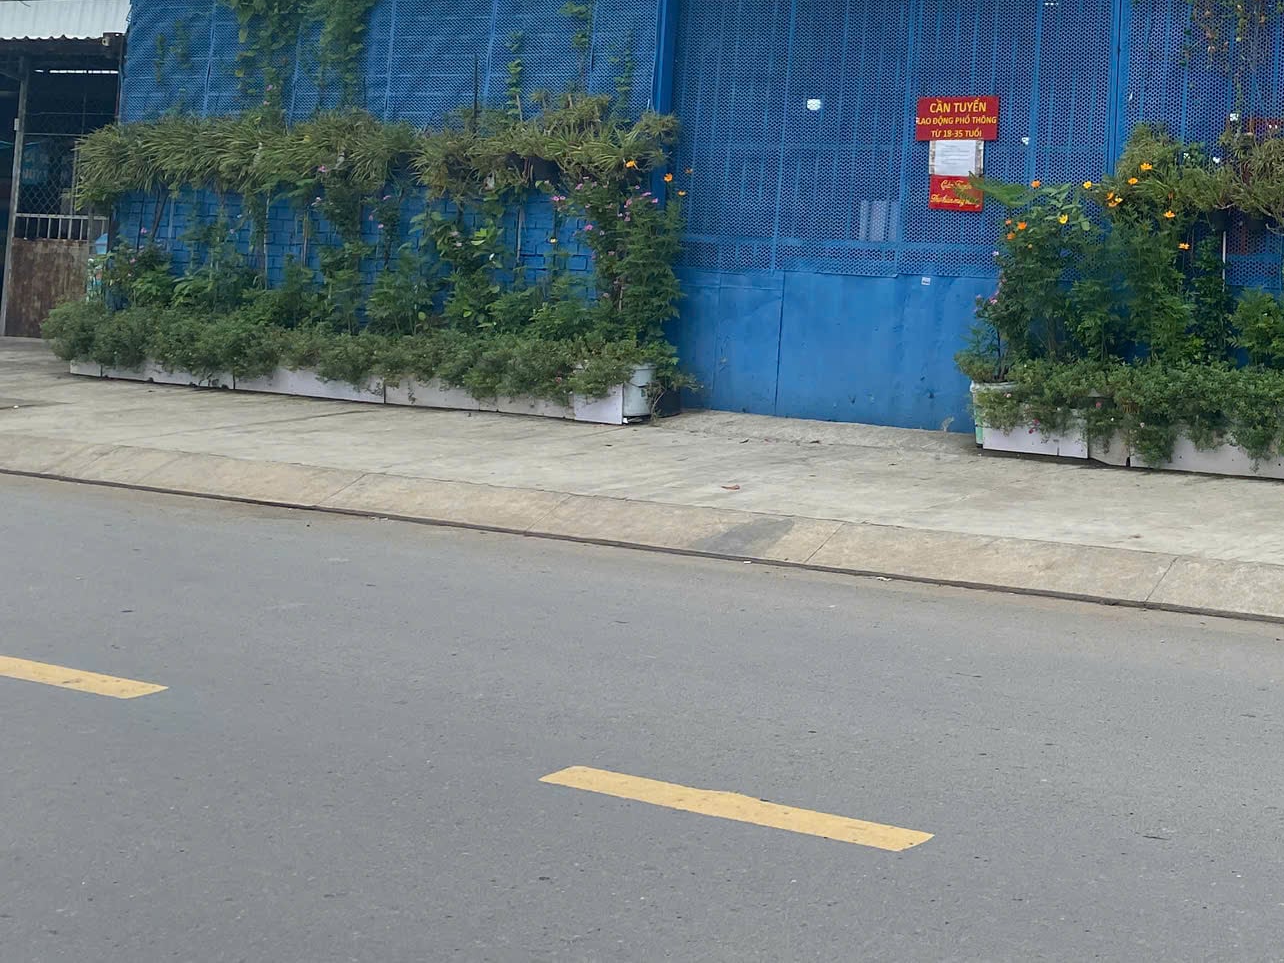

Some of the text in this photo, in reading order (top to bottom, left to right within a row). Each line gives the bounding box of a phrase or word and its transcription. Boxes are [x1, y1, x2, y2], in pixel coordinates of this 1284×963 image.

[930, 98, 987, 113] CẦN TUYỂN
[917, 114, 997, 126] LAO ĐỘNG PHỔ THÔNG
[931, 128, 982, 137] TỪ 18-35 TUỔI
